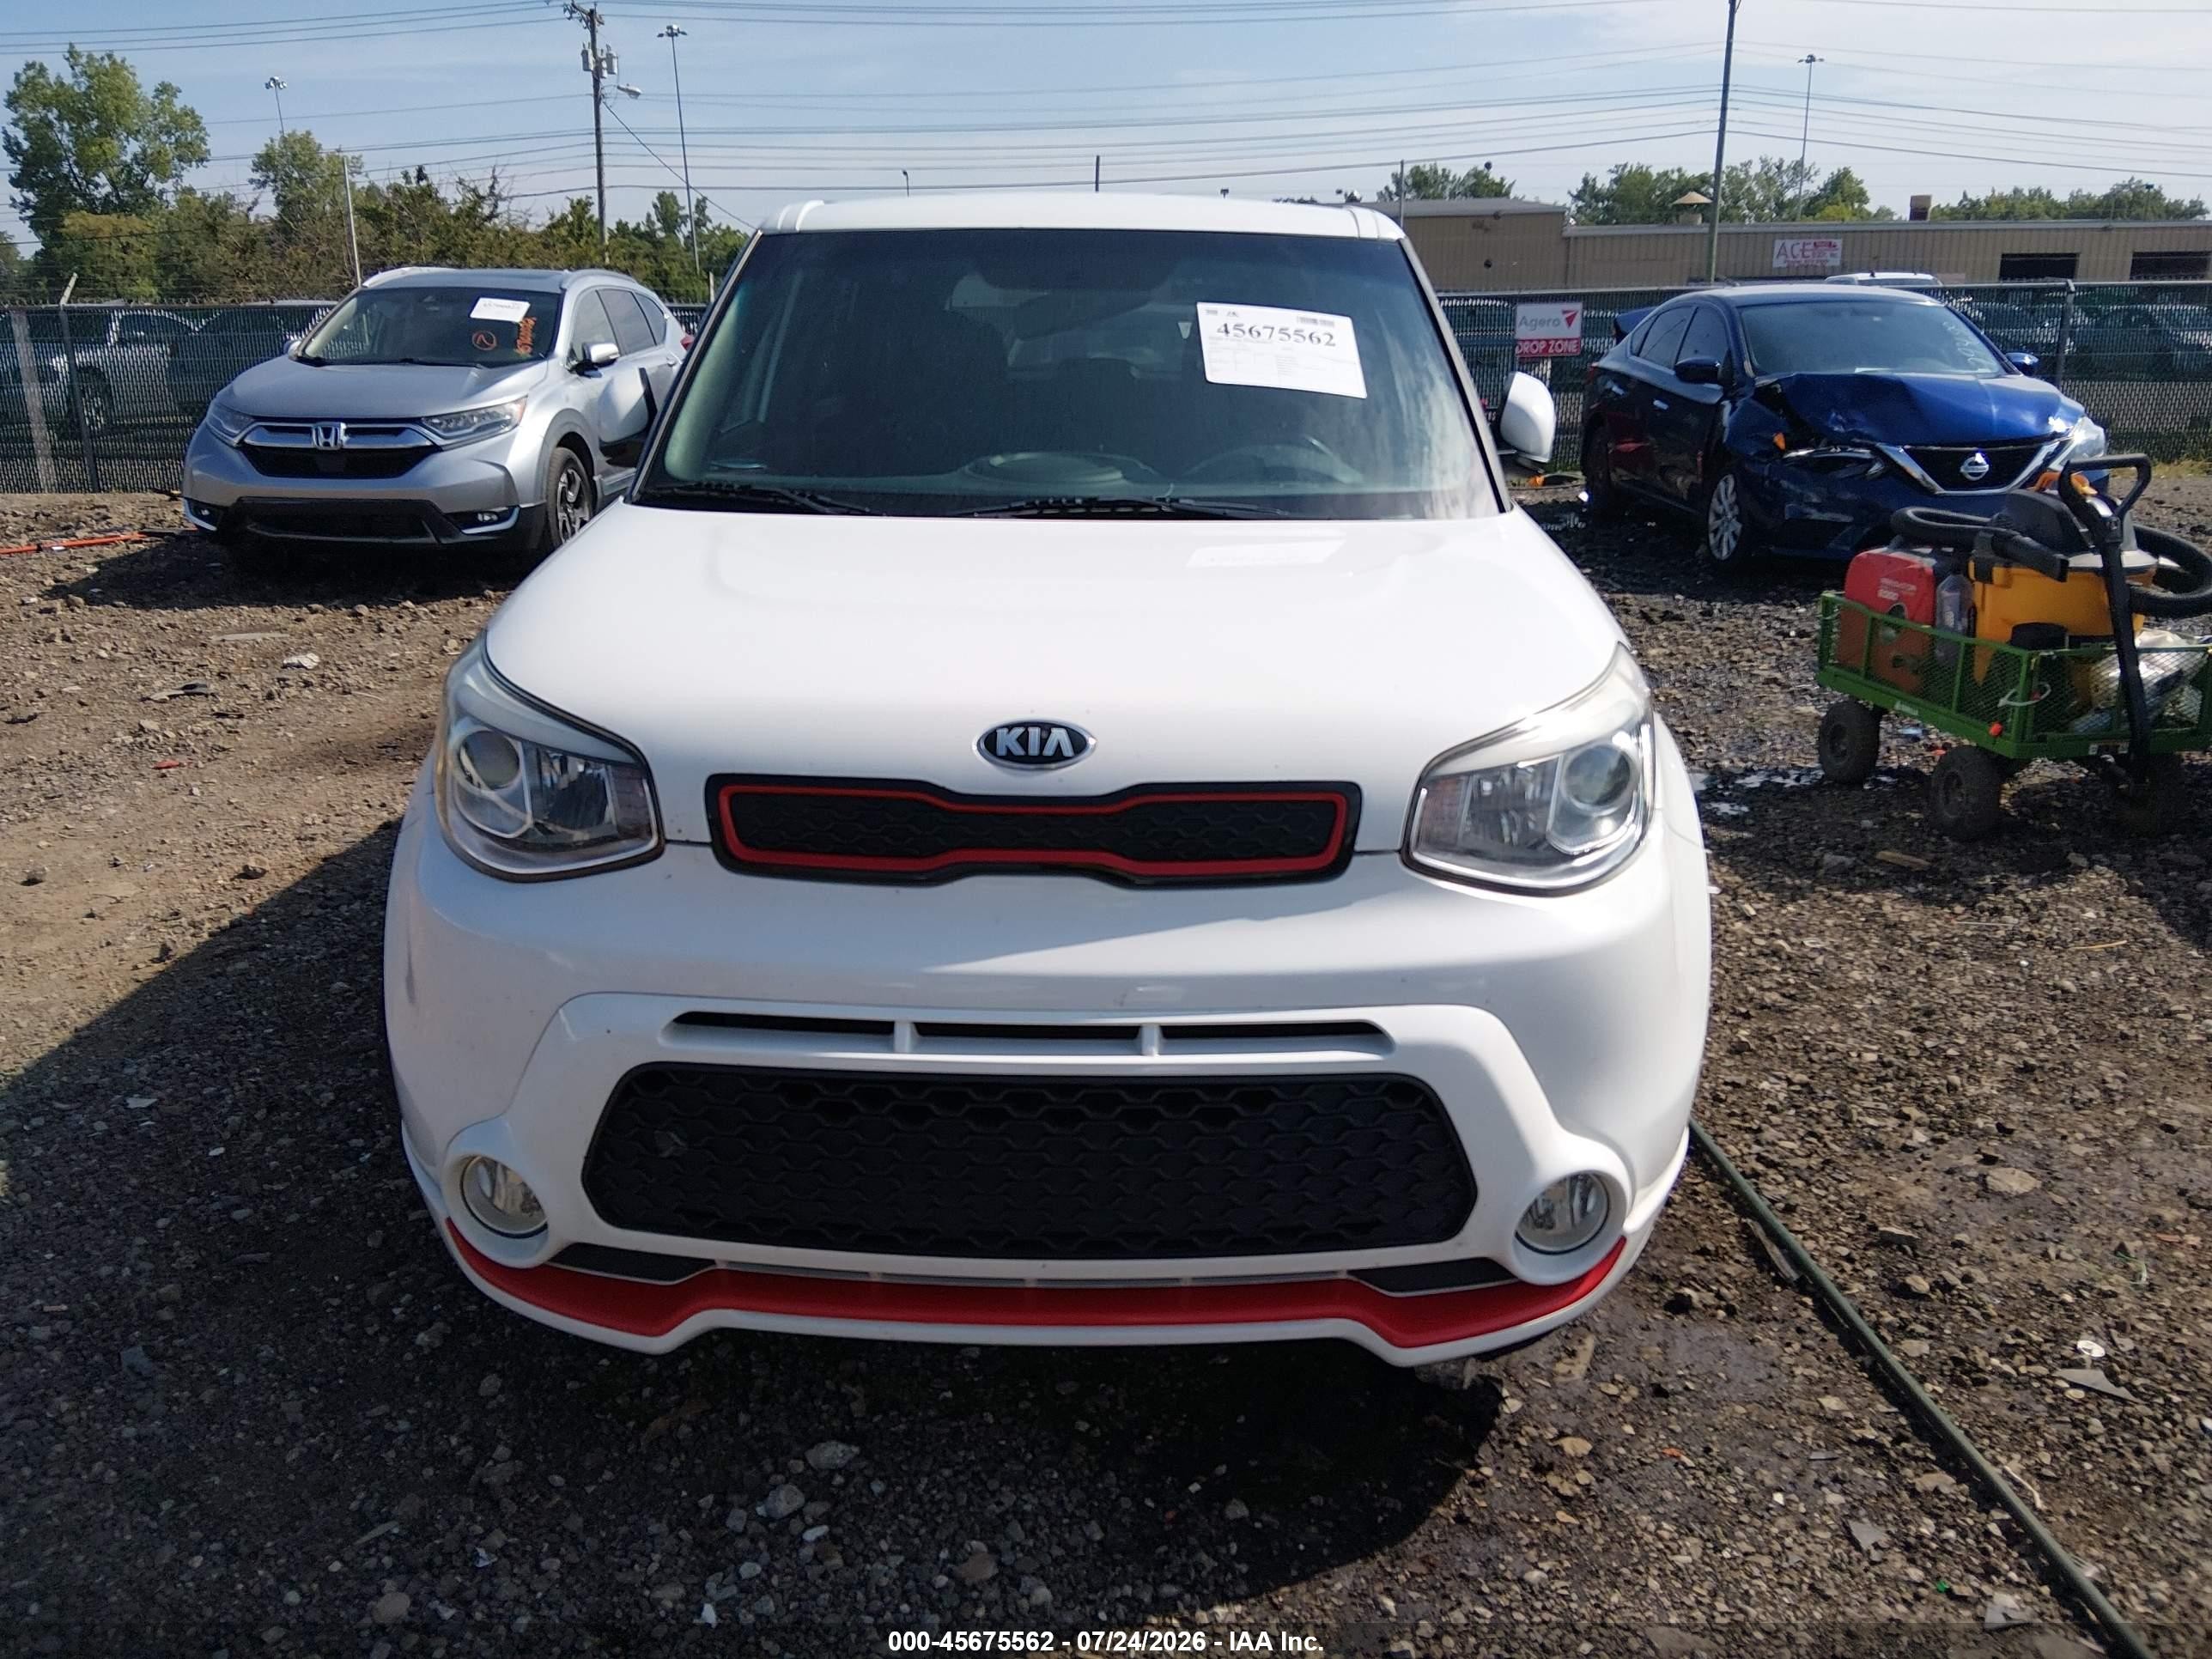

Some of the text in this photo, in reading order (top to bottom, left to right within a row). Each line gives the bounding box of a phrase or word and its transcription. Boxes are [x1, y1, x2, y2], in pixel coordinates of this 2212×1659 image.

[1776, 241, 1812, 258] ACE
[1518, 315, 1561, 331] Agero
[1217, 322, 1336, 347] 45675562
[1516, 339, 1578, 355] DROP ZONE
[995, 726, 1074, 757] KIA
